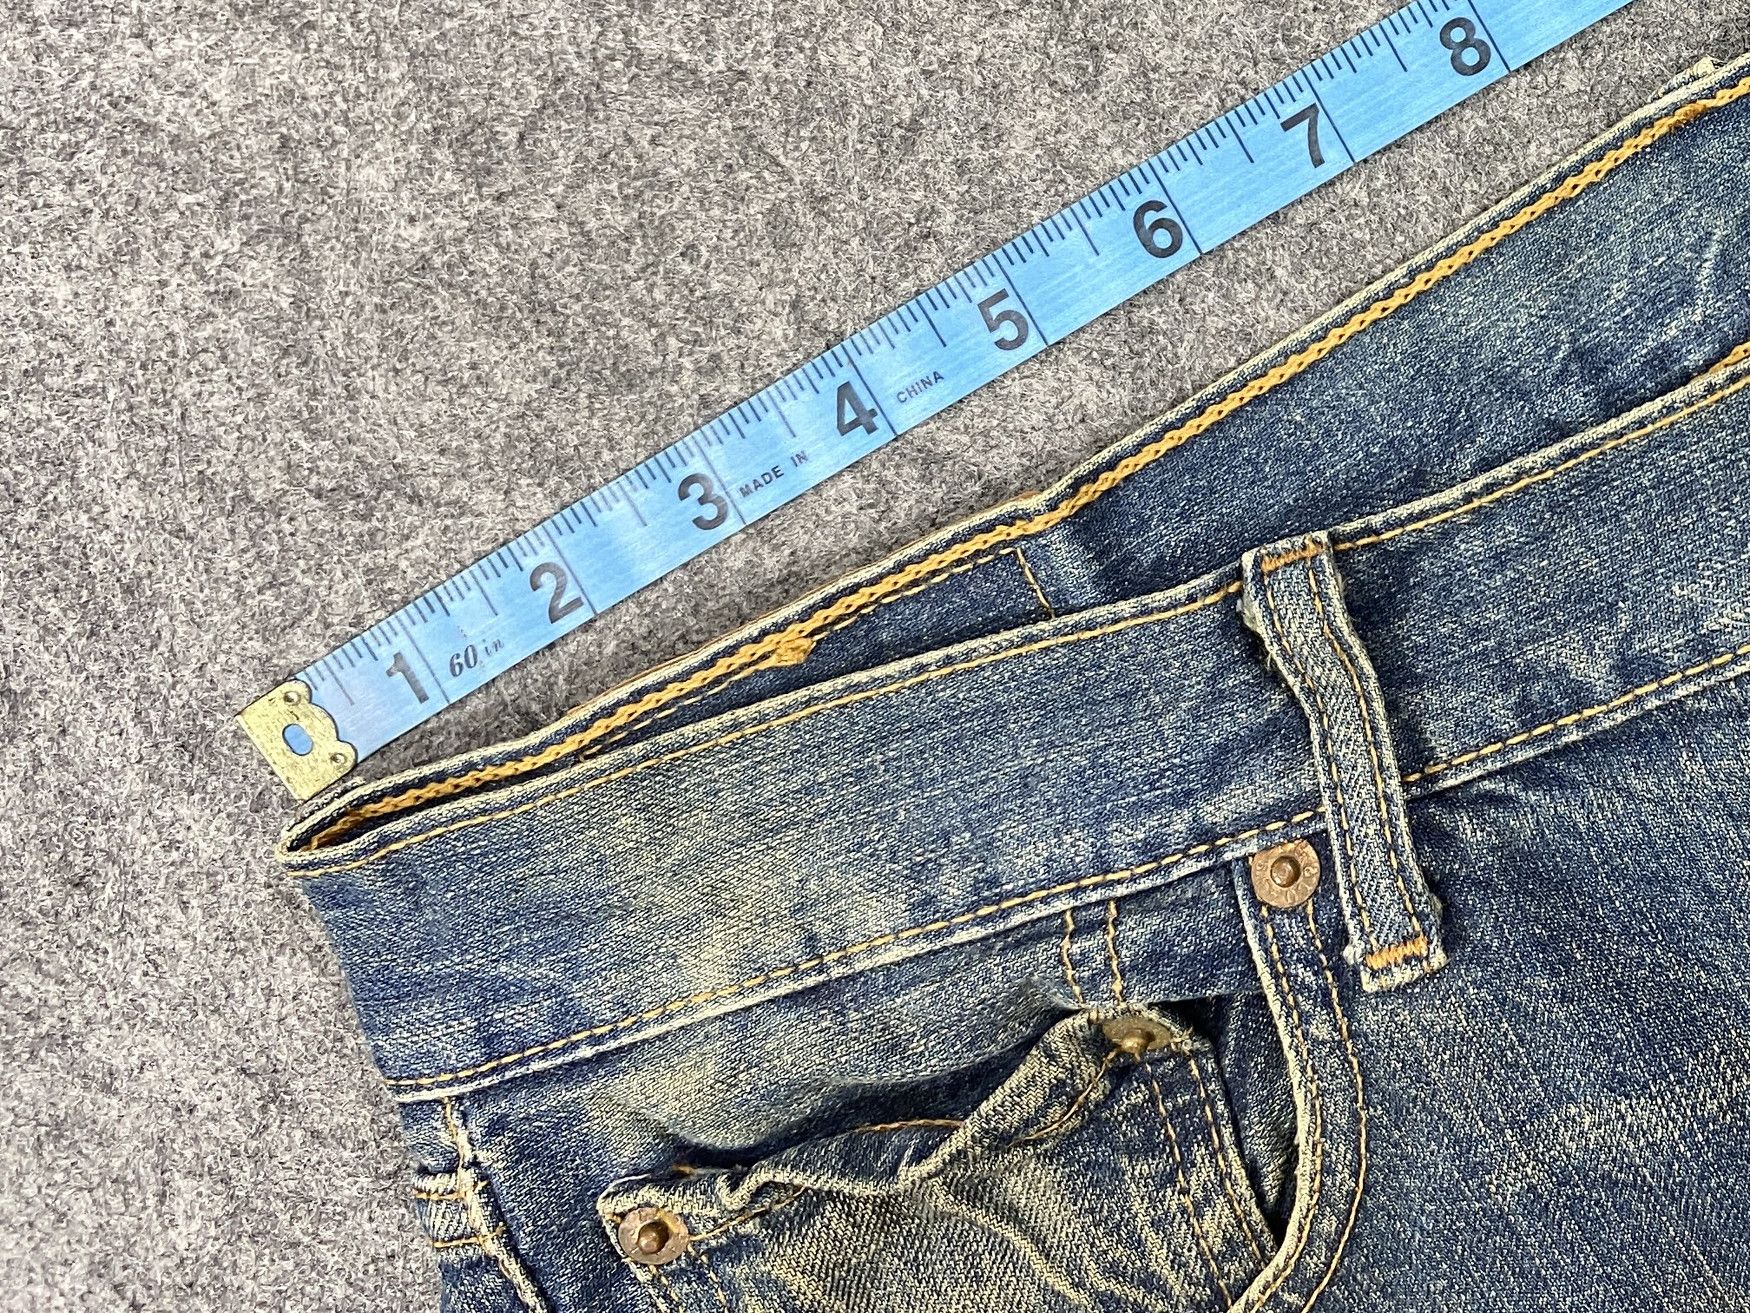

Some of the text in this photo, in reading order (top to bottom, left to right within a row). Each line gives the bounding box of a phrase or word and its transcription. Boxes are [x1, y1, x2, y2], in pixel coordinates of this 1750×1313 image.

[1439, 17, 1491, 76] 8
[1280, 103, 1325, 168] 7
[1133, 200, 1184, 258] 6
[980, 288, 1028, 351] 5
[739, 370, 945, 499] MADE IN CHINA
[835, 382, 878, 437] 4
[678, 473, 729, 531] 3
[529, 562, 584, 624] 2
[386, 652, 430, 704] 1
[449, 637, 505, 678] 60 in
